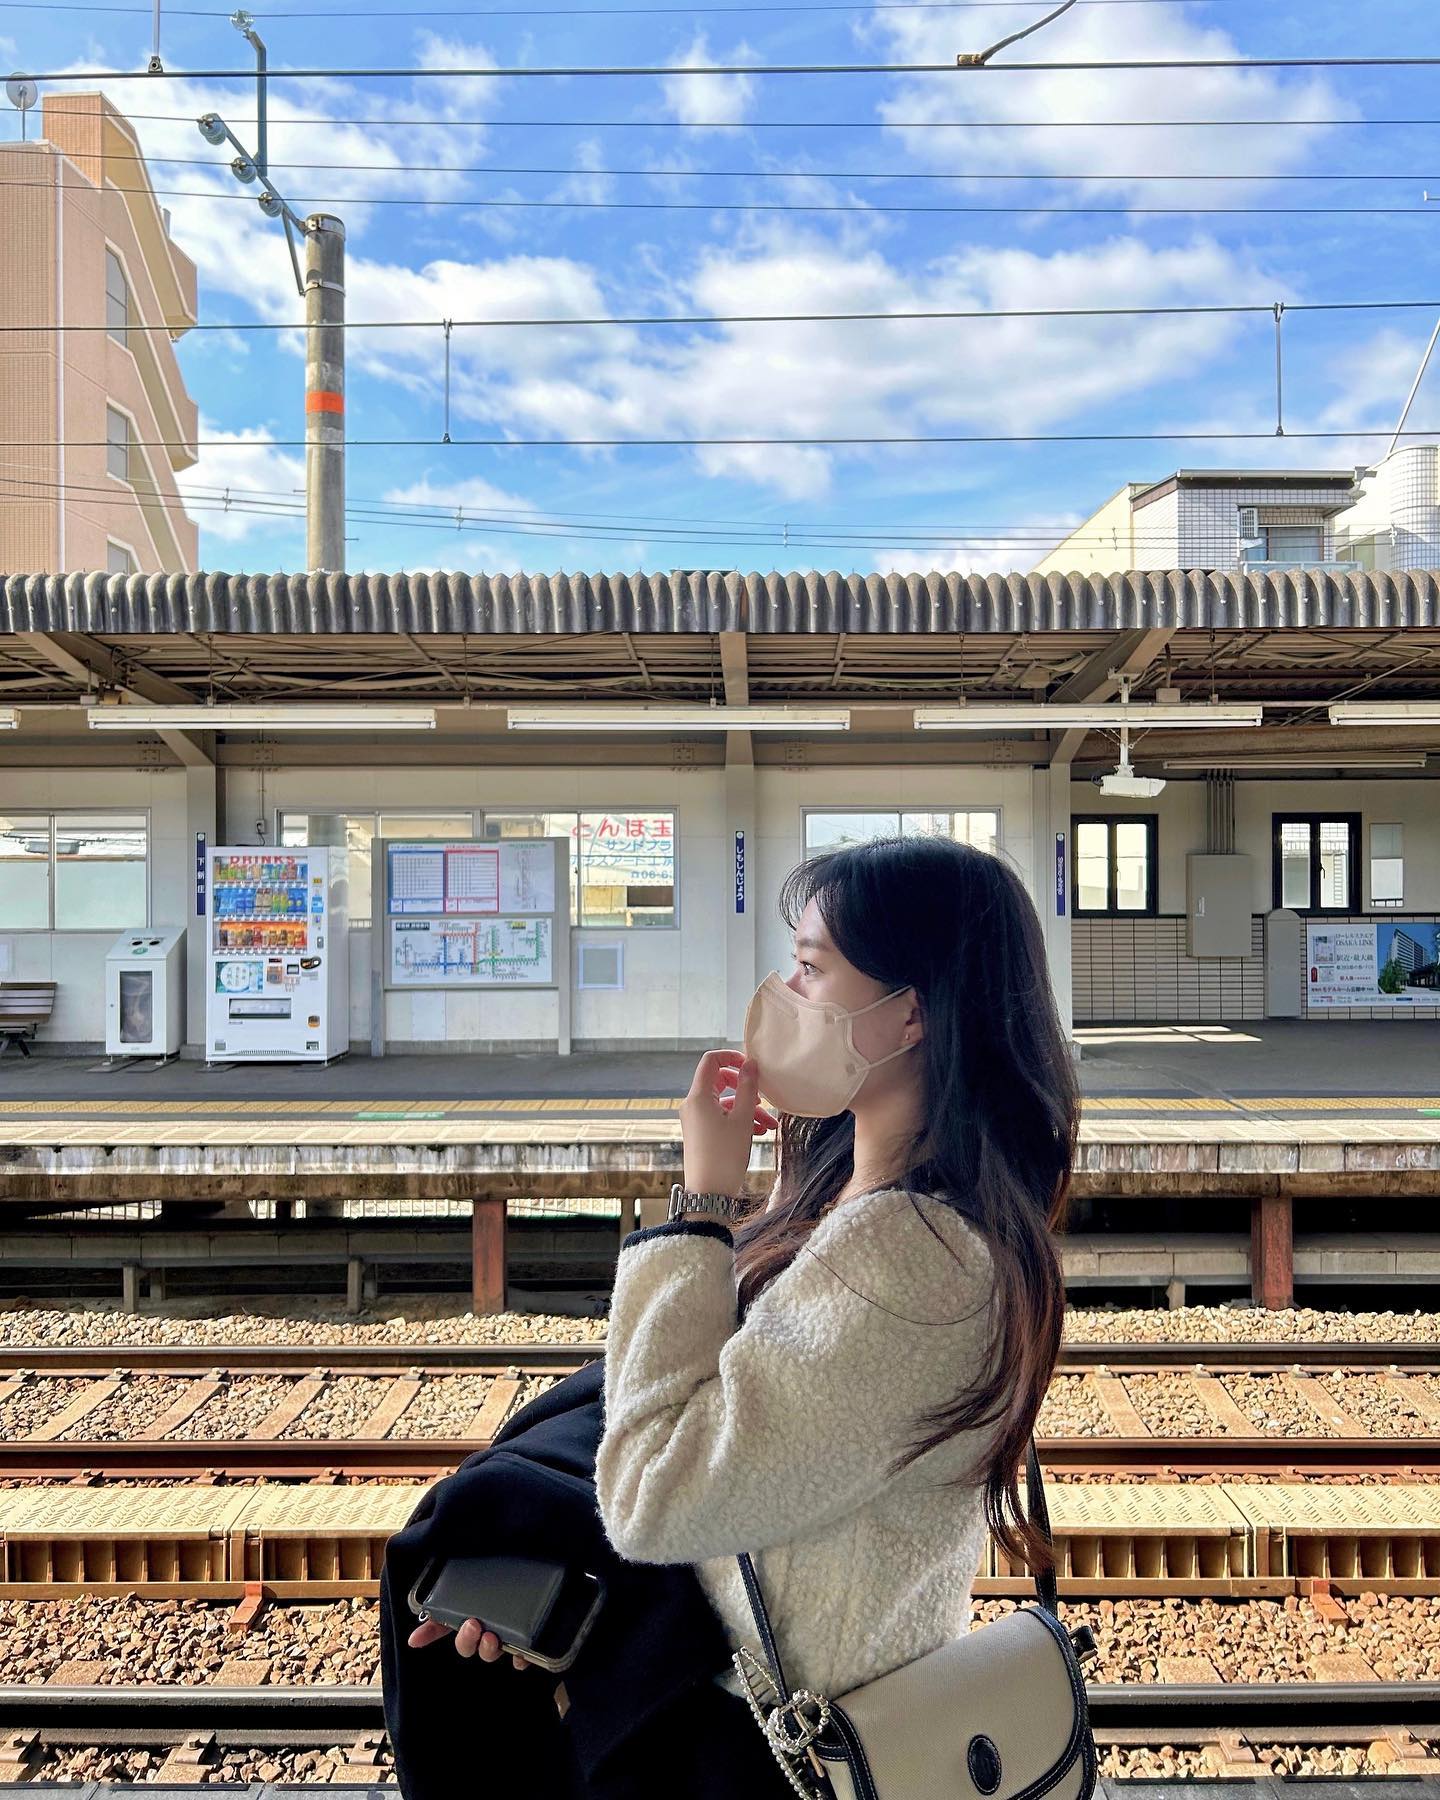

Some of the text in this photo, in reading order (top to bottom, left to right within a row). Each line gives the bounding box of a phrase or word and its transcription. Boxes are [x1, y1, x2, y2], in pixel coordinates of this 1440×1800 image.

[230, 855, 296, 865] DRINKS
[736, 845, 744, 901] しもしんじょう
